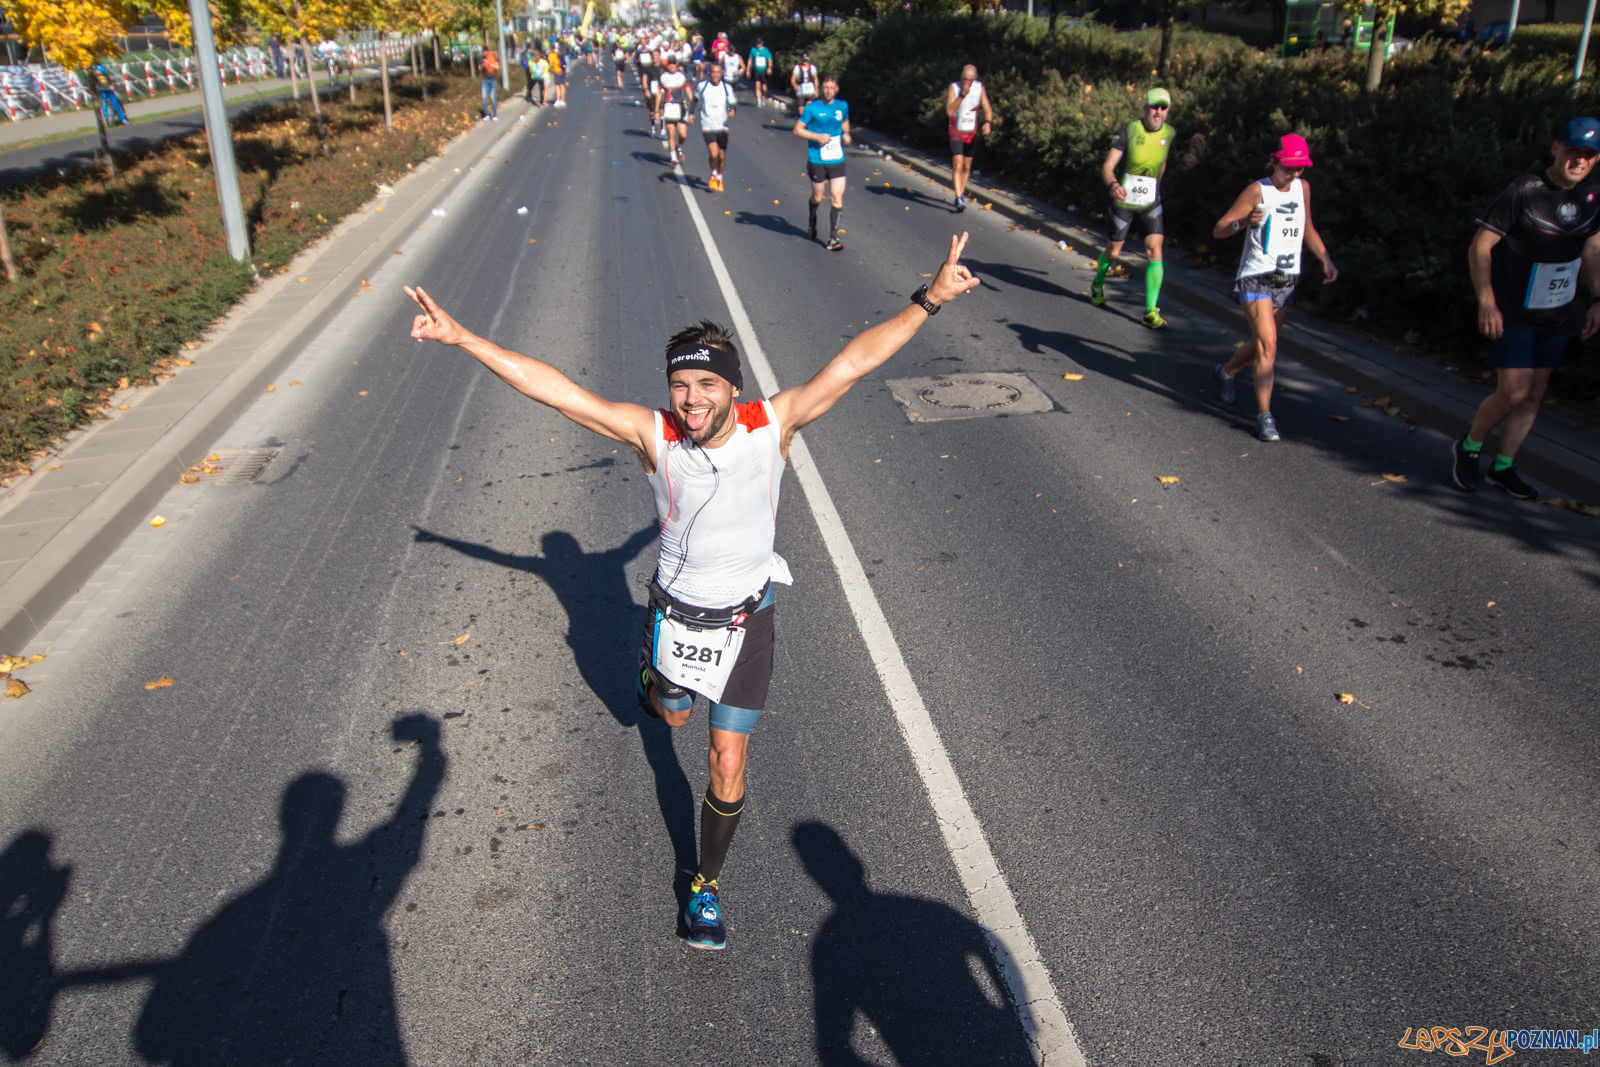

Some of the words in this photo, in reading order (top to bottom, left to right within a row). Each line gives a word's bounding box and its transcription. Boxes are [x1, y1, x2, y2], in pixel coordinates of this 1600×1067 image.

[1282, 228, 1300, 238] 918
[1548, 276, 1570, 290] 576
[671, 353, 710, 364] marathon
[671, 641, 723, 667] 3281
[682, 663, 707, 672] Mariusz
